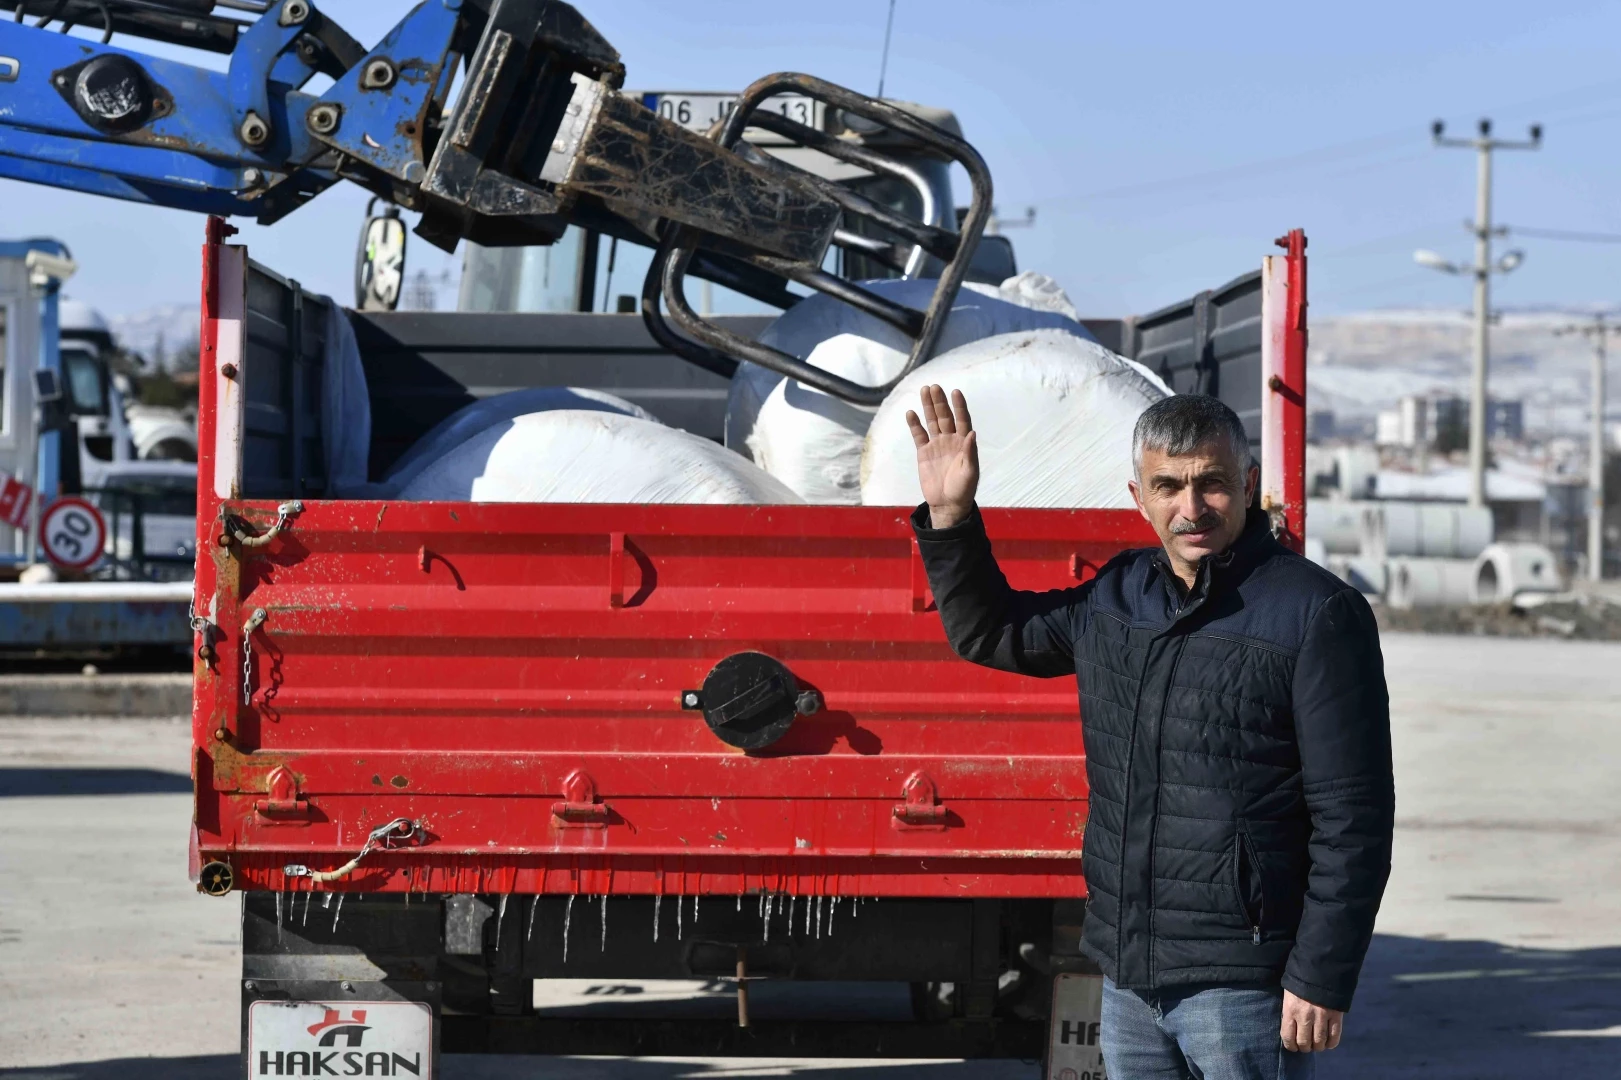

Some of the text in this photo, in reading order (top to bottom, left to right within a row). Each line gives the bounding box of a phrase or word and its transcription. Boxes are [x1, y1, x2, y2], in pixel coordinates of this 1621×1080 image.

[660, 100, 691, 124] 06
[53, 511, 92, 557] 30
[260, 1051, 420, 1076] HAKSAN
